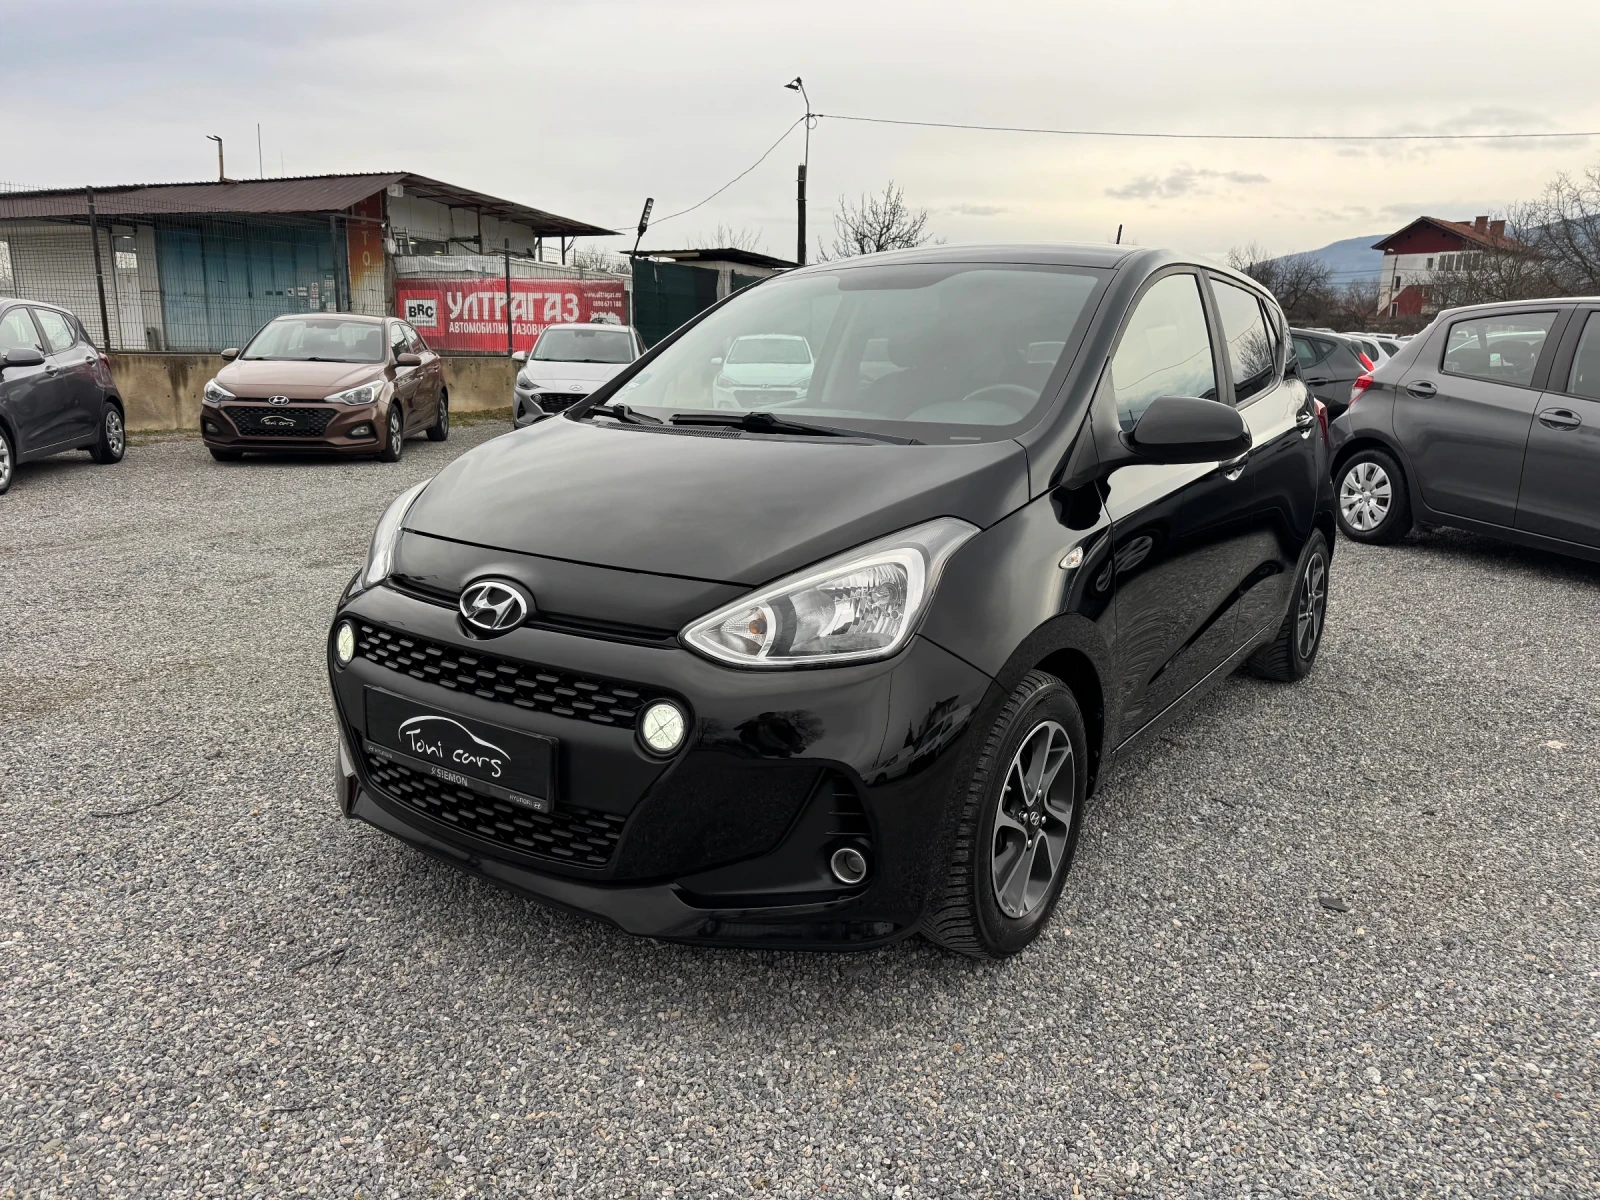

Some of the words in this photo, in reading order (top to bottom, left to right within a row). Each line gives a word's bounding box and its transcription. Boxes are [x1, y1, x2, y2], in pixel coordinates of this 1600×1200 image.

[409, 304, 434, 318] BRC
[446, 291, 580, 323] УЛТРАГАЗ
[405, 728, 443, 758] Toni
[452, 749, 502, 778] cars
[436, 767, 468, 787] SIEMON
